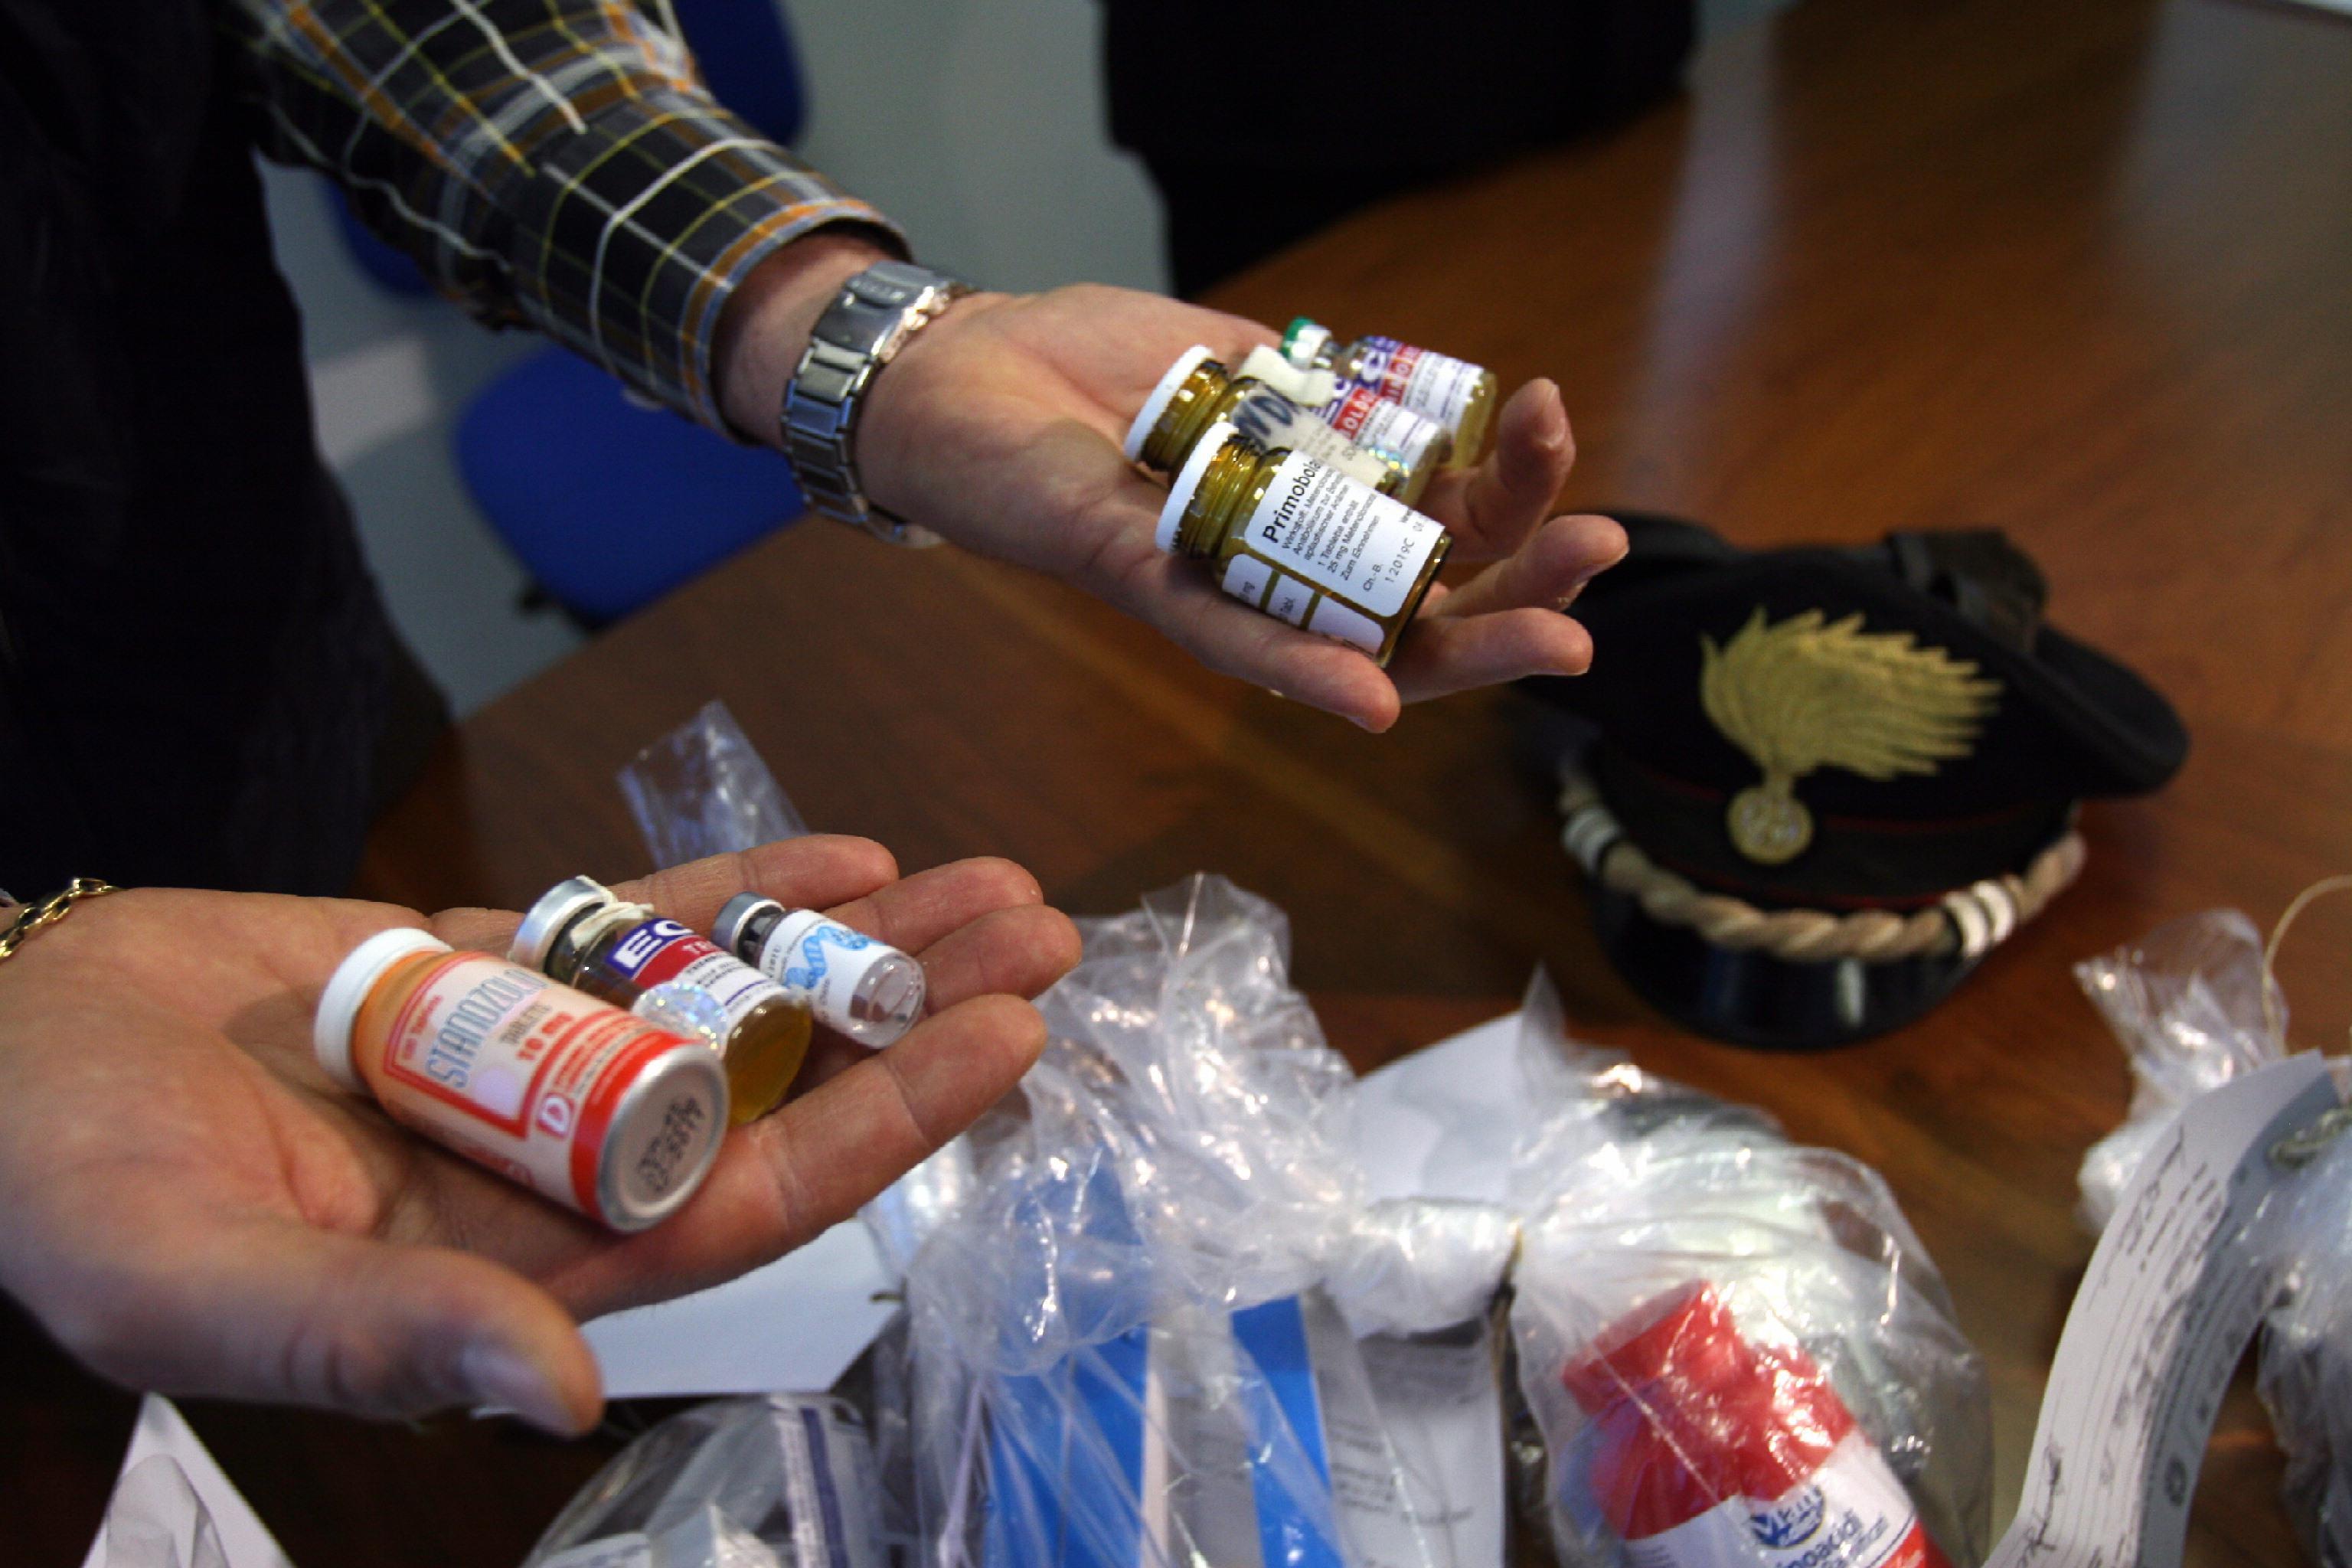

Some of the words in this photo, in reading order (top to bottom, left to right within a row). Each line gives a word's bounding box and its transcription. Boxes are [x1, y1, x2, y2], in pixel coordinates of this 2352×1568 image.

[1319, 523, 1344, 558] Tablette
[1327, 559, 1338, 573] 25
[1334, 544, 1348, 560] mg
[1340, 558, 1356, 580] Zum
[516, 1037, 544, 1060] 10
[541, 1012, 573, 1036] mg
